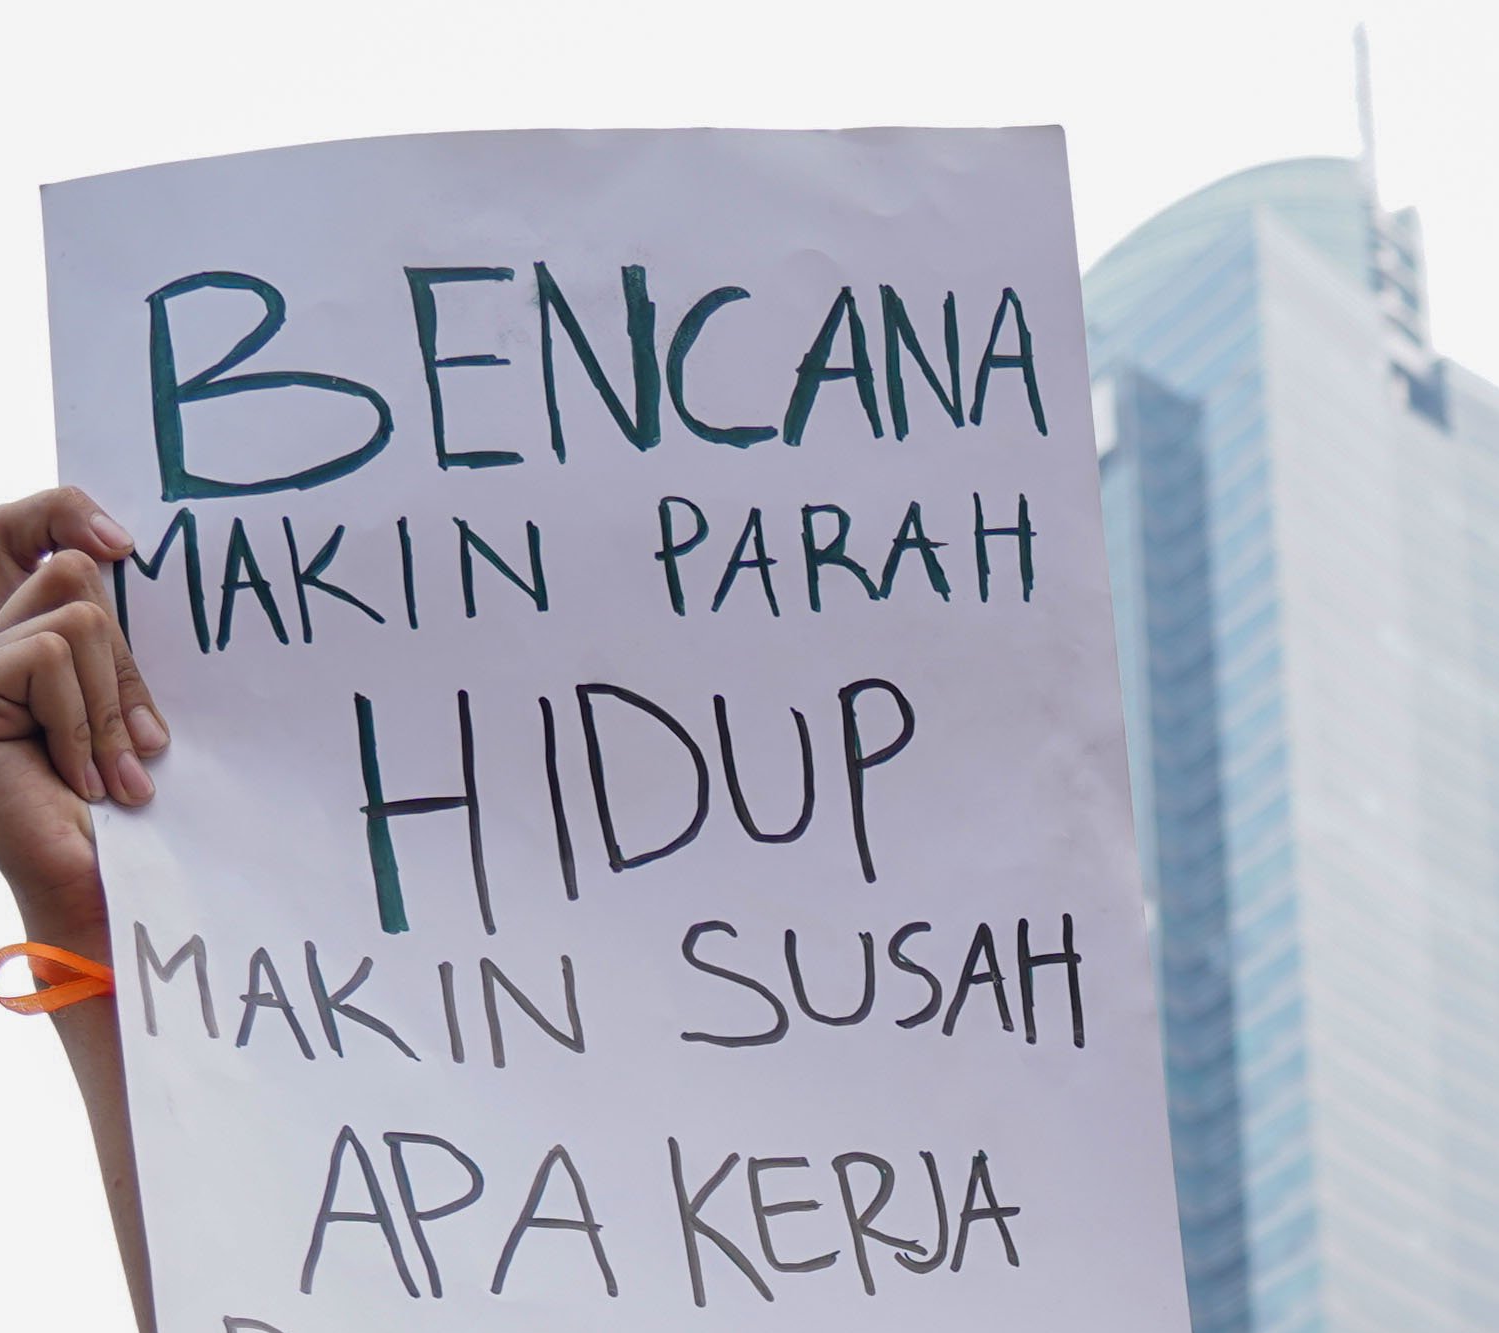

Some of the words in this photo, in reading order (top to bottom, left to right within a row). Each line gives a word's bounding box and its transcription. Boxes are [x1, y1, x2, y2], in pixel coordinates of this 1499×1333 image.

[146, 262, 1048, 502] BENCANA
[112, 507, 549, 652] MAKIN
[655, 493, 1038, 615] PARAH
[353, 678, 916, 934] HIDUP
[134, 920, 585, 1069] MAKIN
[682, 912, 1088, 1048] SUSAH
[301, 1124, 617, 1298] APA
[668, 1136, 1022, 1306] KERJA
